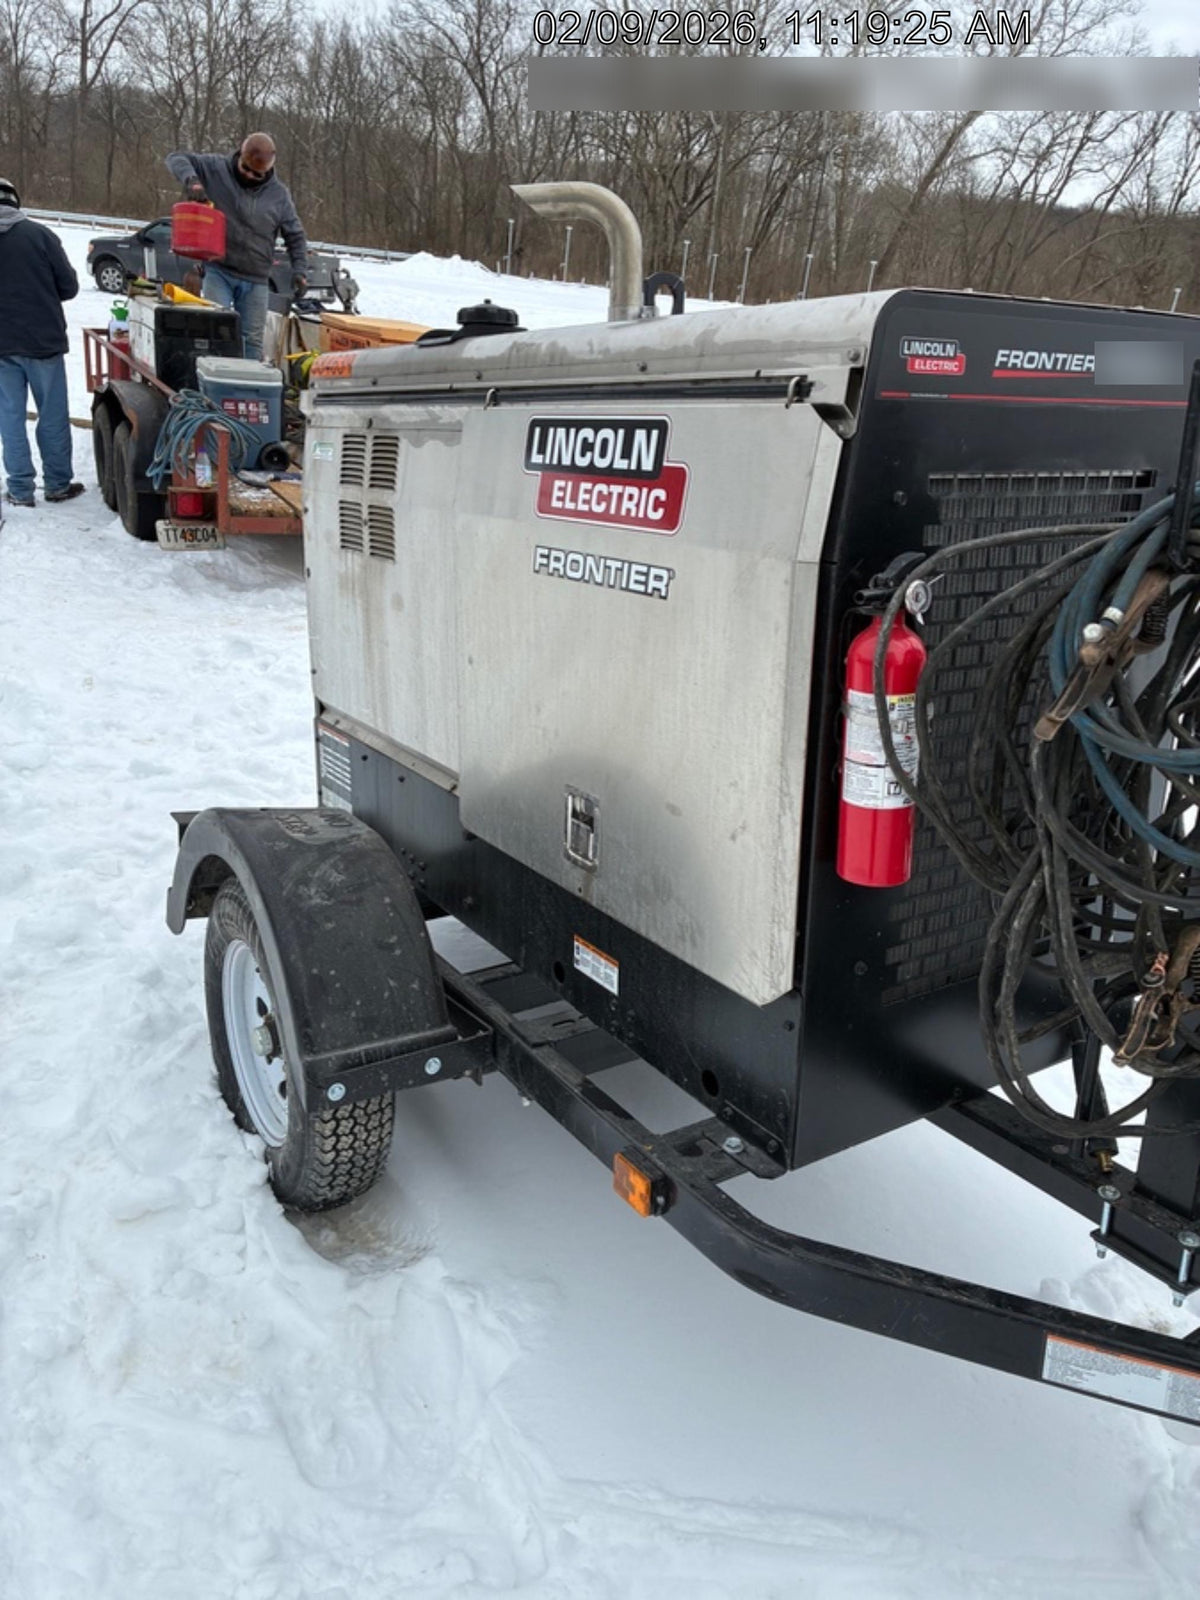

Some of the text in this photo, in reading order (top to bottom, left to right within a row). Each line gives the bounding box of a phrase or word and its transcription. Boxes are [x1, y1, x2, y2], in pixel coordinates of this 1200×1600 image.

[903, 341, 955, 357] LINCOLN
[994, 349, 1095, 372] FRONTIER
[914, 358, 960, 372] ELECTRIC
[531, 427, 659, 472] LINCOLN
[551, 480, 667, 520] ELECTRIC
[533, 545, 672, 599] FRONTIER
